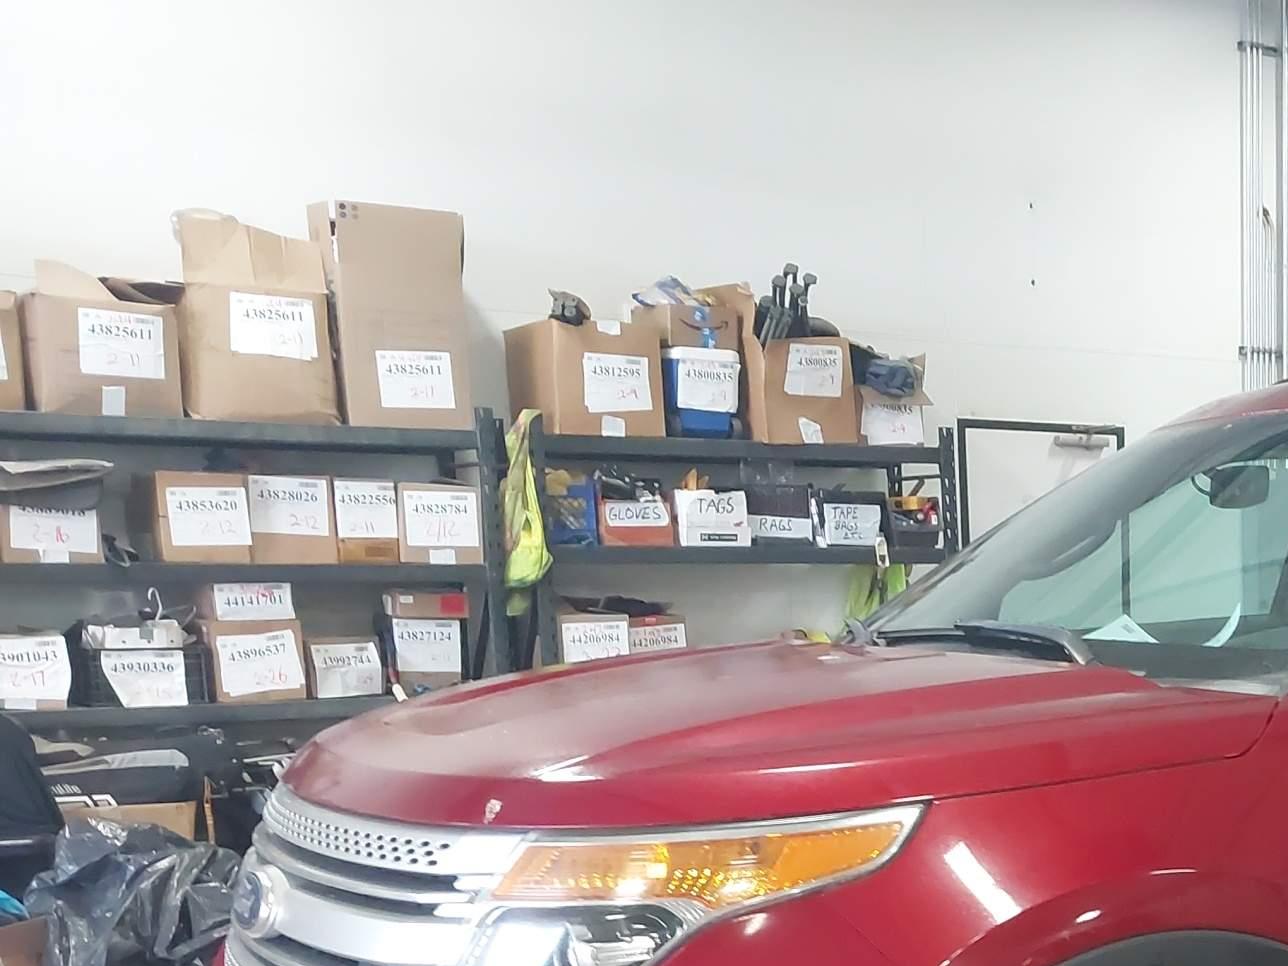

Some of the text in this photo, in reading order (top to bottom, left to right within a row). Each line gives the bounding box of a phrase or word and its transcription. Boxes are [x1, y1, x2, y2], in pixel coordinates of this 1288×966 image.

[243, 308, 304, 322] 43825611
[88, 323, 152, 341] 43825611
[386, 363, 441, 375] 43825611
[798, 357, 838, 368] 43800835
[591, 365, 641, 377] 43812595
[685, 368, 733, 382] 43800835
[257, 488, 318, 502] 43828026
[339, 494, 396, 506] 43822556
[176, 499, 237, 511] 43853620
[412, 503, 468, 515] 43828784
[696, 496, 735, 514] TAGS
[608, 506, 662, 520] GLOVES
[831, 506, 858, 519] TAPE
[760, 517, 792, 531] RAGS
[834, 521, 858, 532] BAGS
[398, 631, 452, 641] 43827124
[570, 631, 620, 644] 44206984
[632, 635, 679, 648] 44206984
[229, 643, 286, 662] 43896537
[111, 662, 174, 673] 43930336
